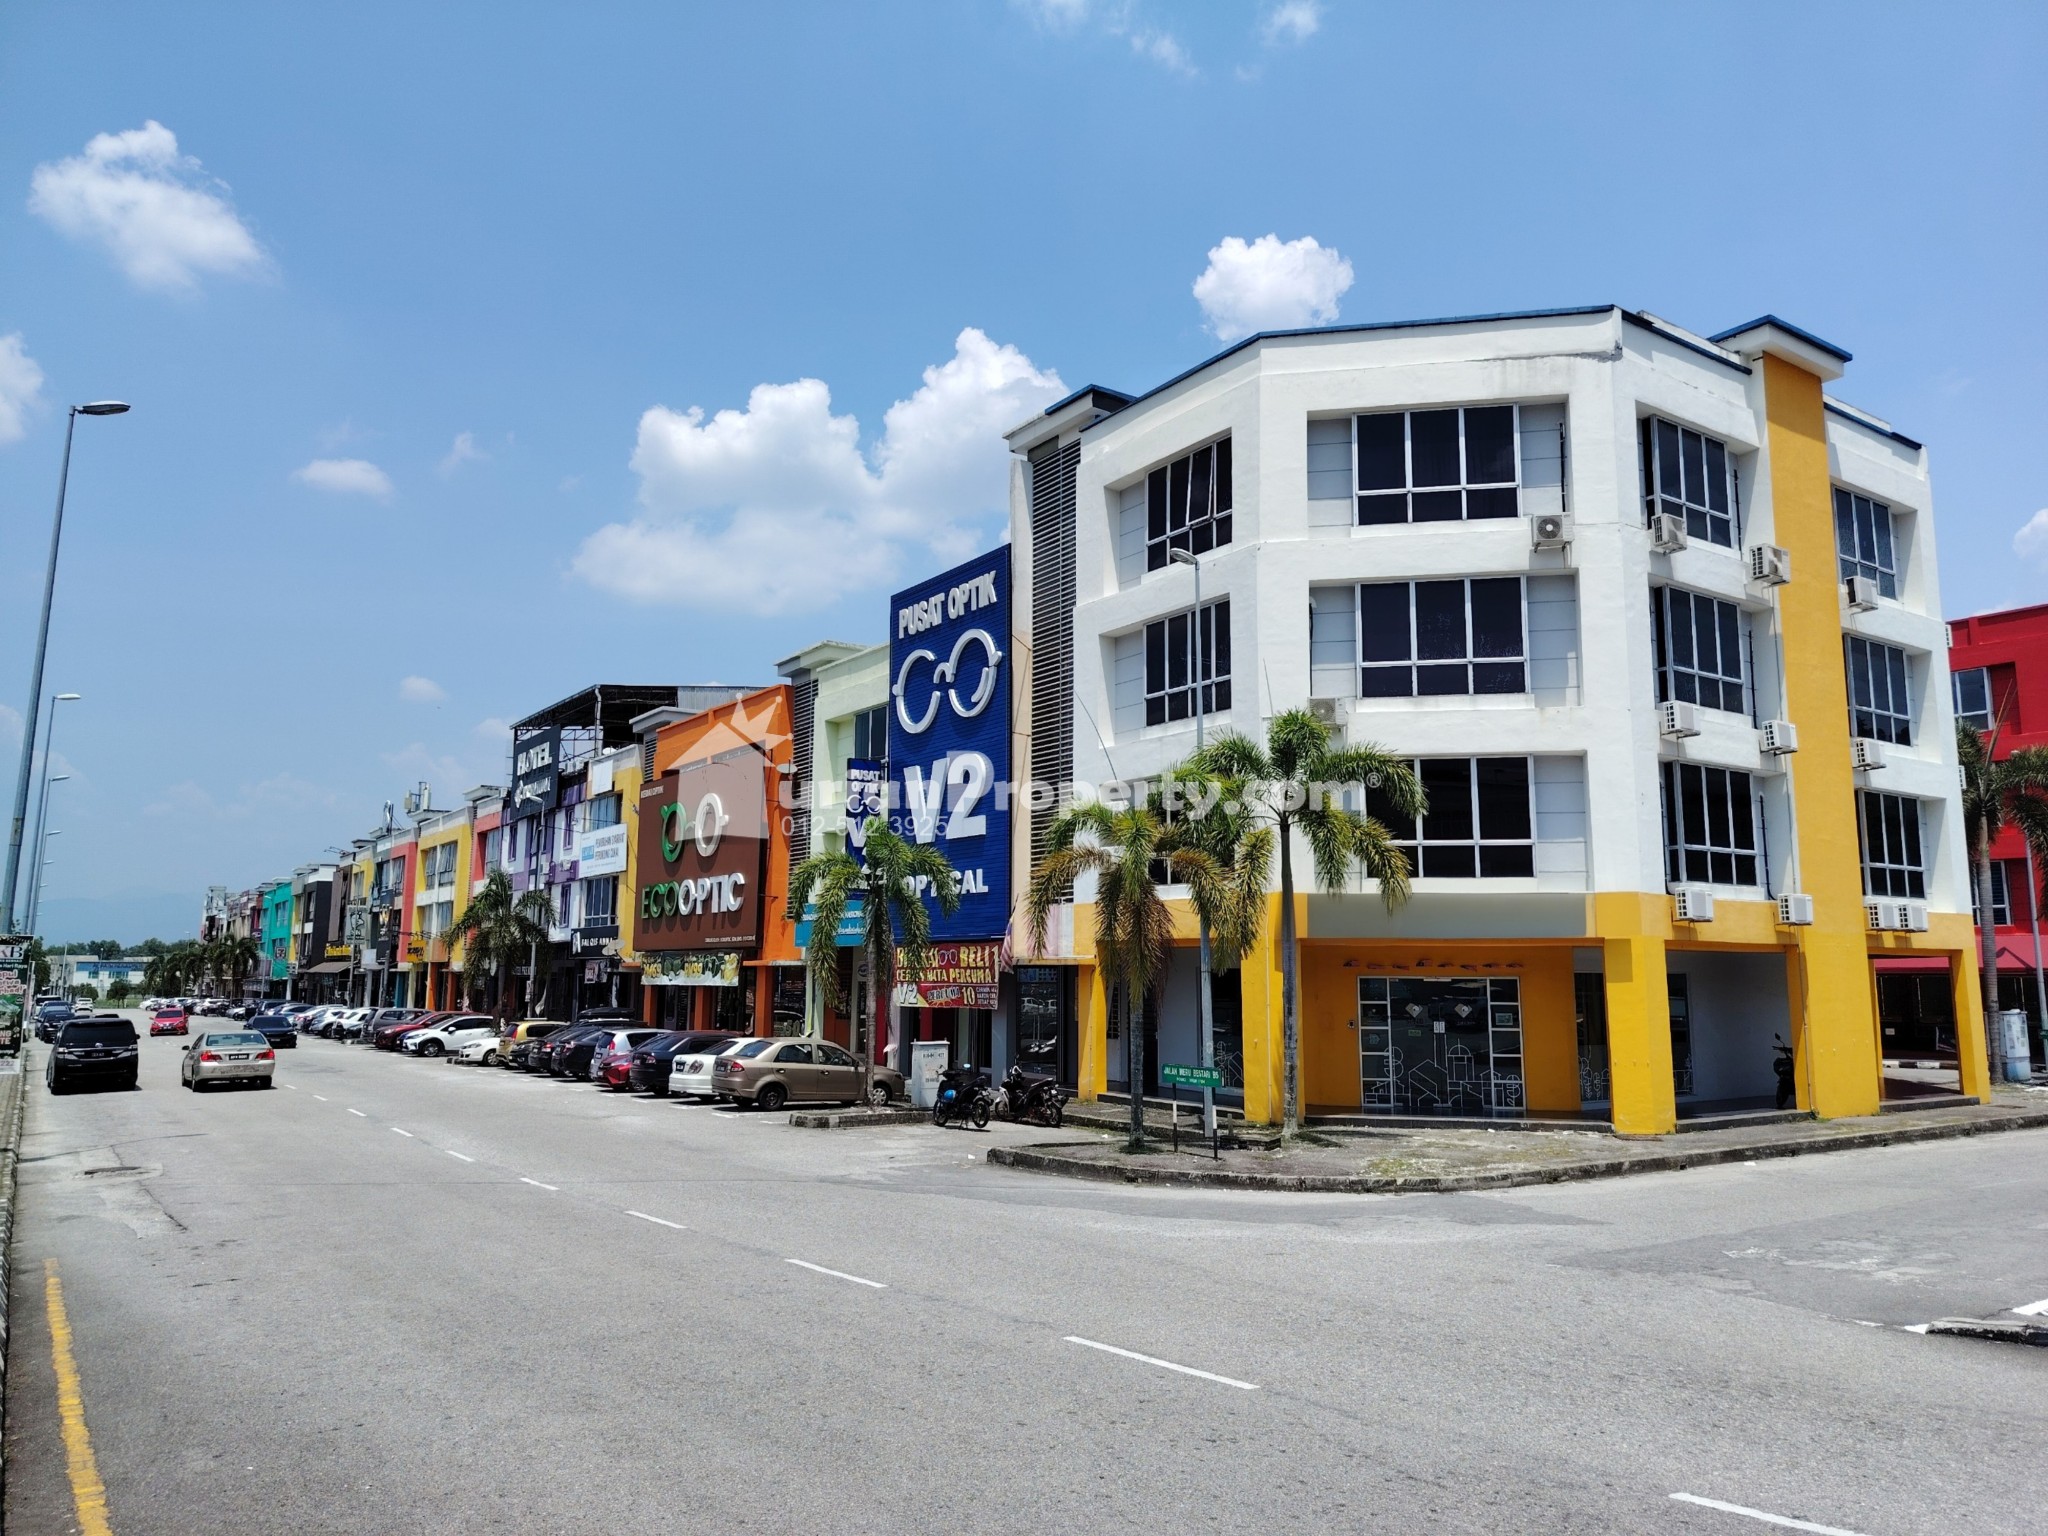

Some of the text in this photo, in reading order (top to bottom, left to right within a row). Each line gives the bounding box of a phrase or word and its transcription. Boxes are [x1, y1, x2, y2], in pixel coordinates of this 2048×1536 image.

[898, 570, 997, 639] PUSAT OPTIK
[517, 741, 552, 776] HOTEL
[850, 769, 880, 781] PUSAT
[851, 782, 880, 794] OPTIK
[903, 753, 987, 844] V2
[903, 868, 989, 898] OPTCAL
[960, 945, 989, 968] BELI
[950, 967, 993, 983] PERCUMA
[897, 982, 975, 1006] V2 PERCUMA 10
[1164, 1067, 1178, 1076] JALAN
[1193, 1069, 1211, 1079] BESTARI
